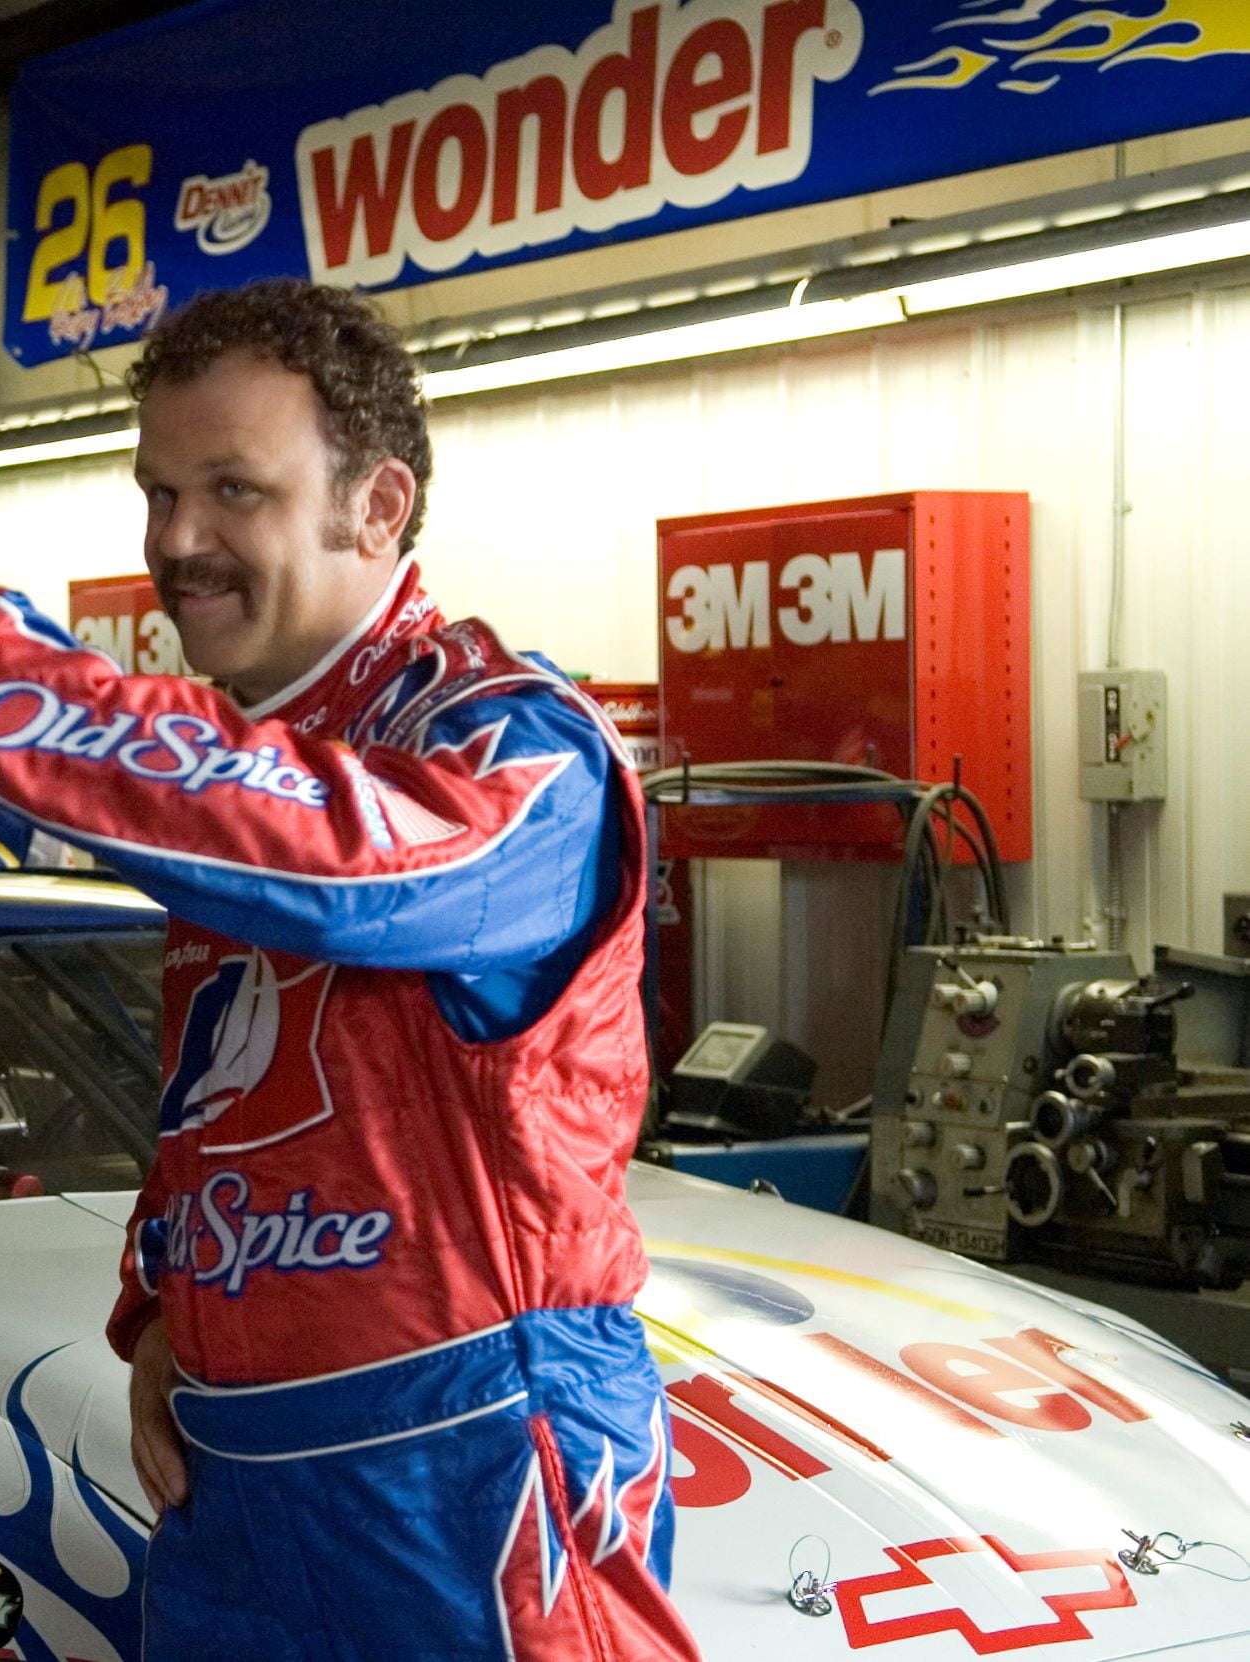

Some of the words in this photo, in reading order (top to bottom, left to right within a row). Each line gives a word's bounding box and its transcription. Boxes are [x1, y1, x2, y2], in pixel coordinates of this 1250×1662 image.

[311, 0, 826, 270] wonder
[22, 144, 154, 324] 26
[666, 564, 771, 654] 3M
[777, 549, 906, 646] 3M
[117, 712, 330, 808] Spice
[193, 1170, 391, 1296] Spice
